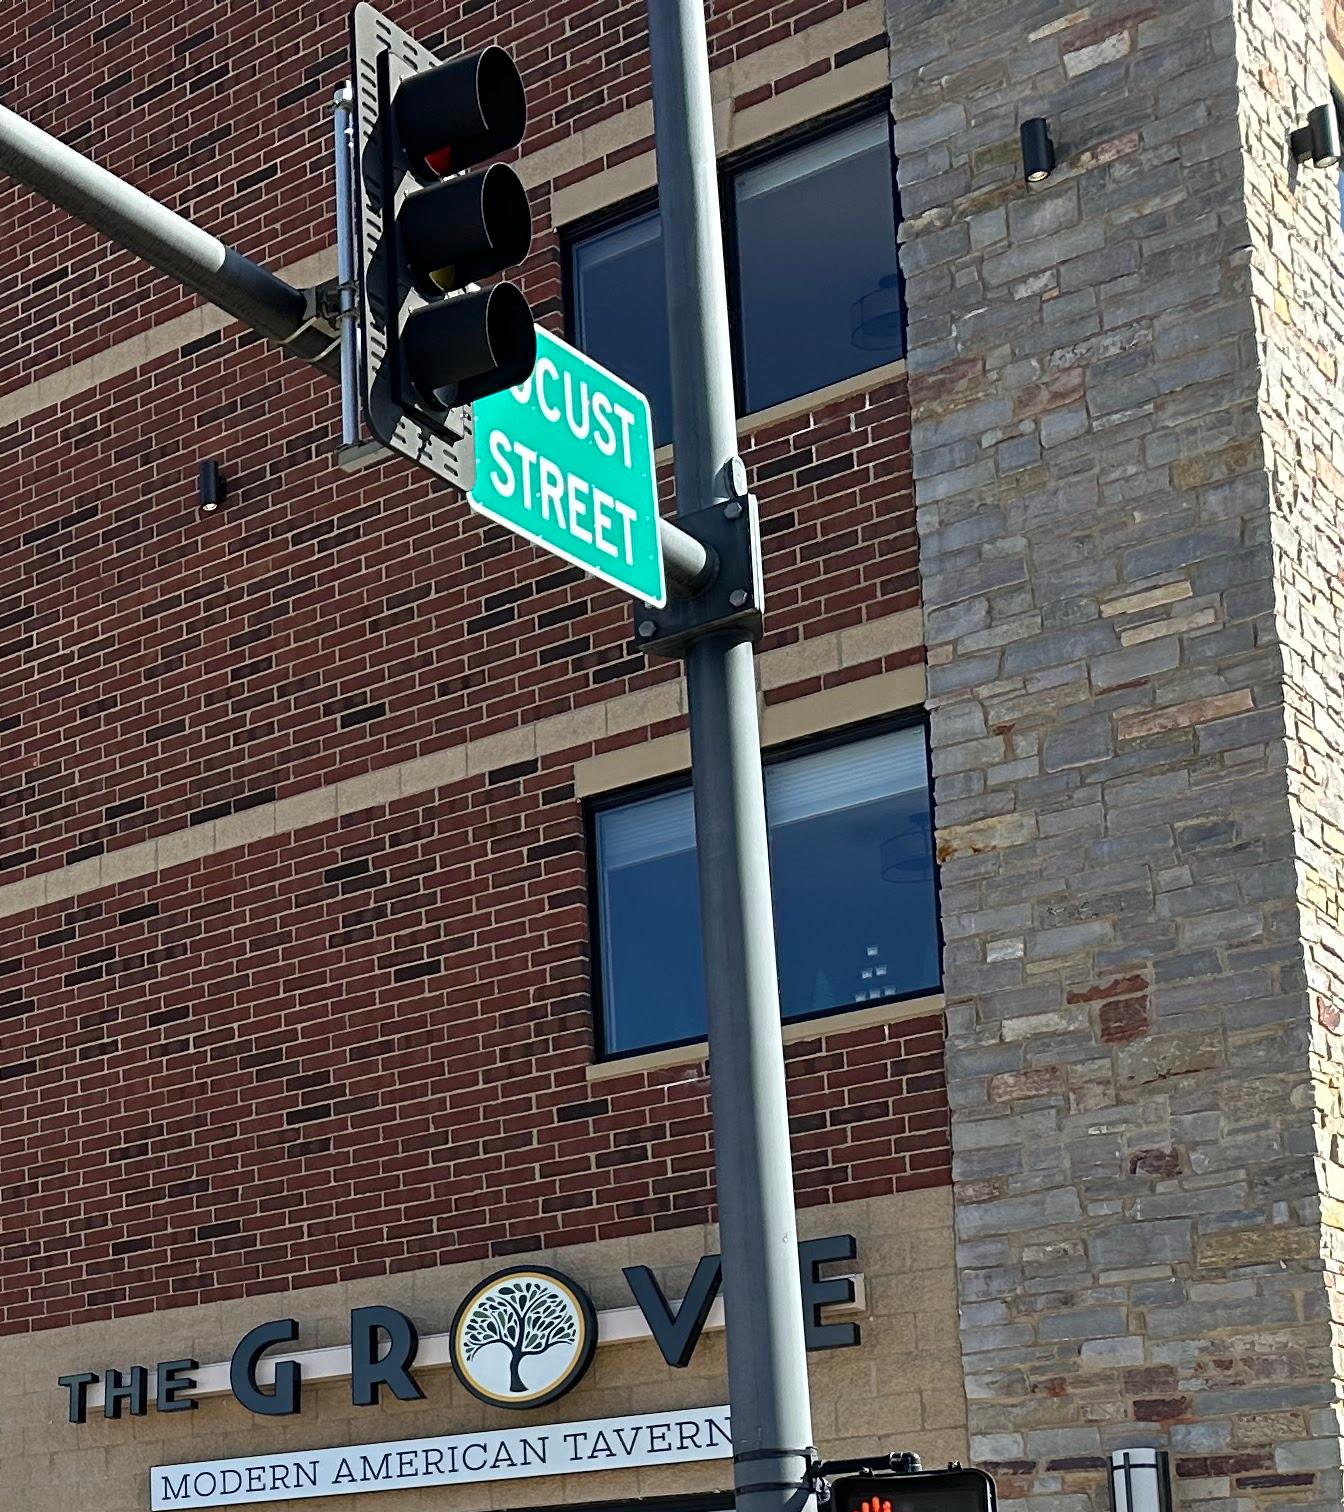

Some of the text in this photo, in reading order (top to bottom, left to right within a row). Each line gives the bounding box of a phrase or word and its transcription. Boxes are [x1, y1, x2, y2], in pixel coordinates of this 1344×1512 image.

[509, 357, 635, 469] CUST
[489, 430, 638, 566] STREET
[58, 1358, 199, 1424] THE
[161, 1416, 733, 1501] MODERN AMERICAN TAVERN
